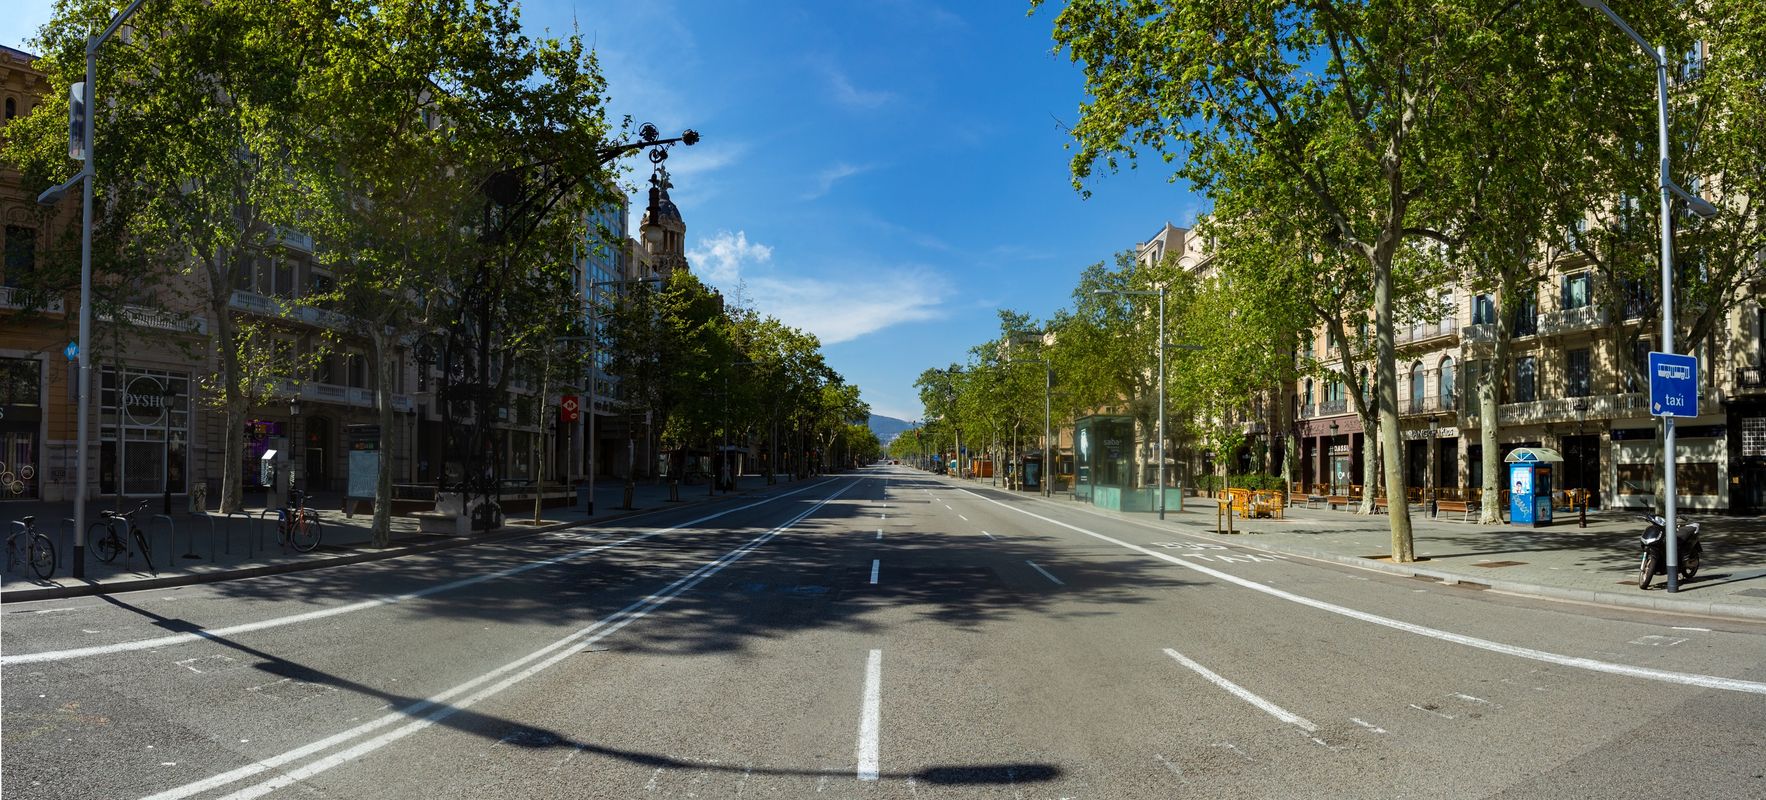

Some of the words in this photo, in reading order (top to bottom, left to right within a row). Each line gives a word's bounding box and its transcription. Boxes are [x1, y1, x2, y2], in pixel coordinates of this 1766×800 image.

[68, 347, 75, 355] W
[1151, 541, 1229, 551] BUS
[1182, 553, 1289, 563] TAXI
